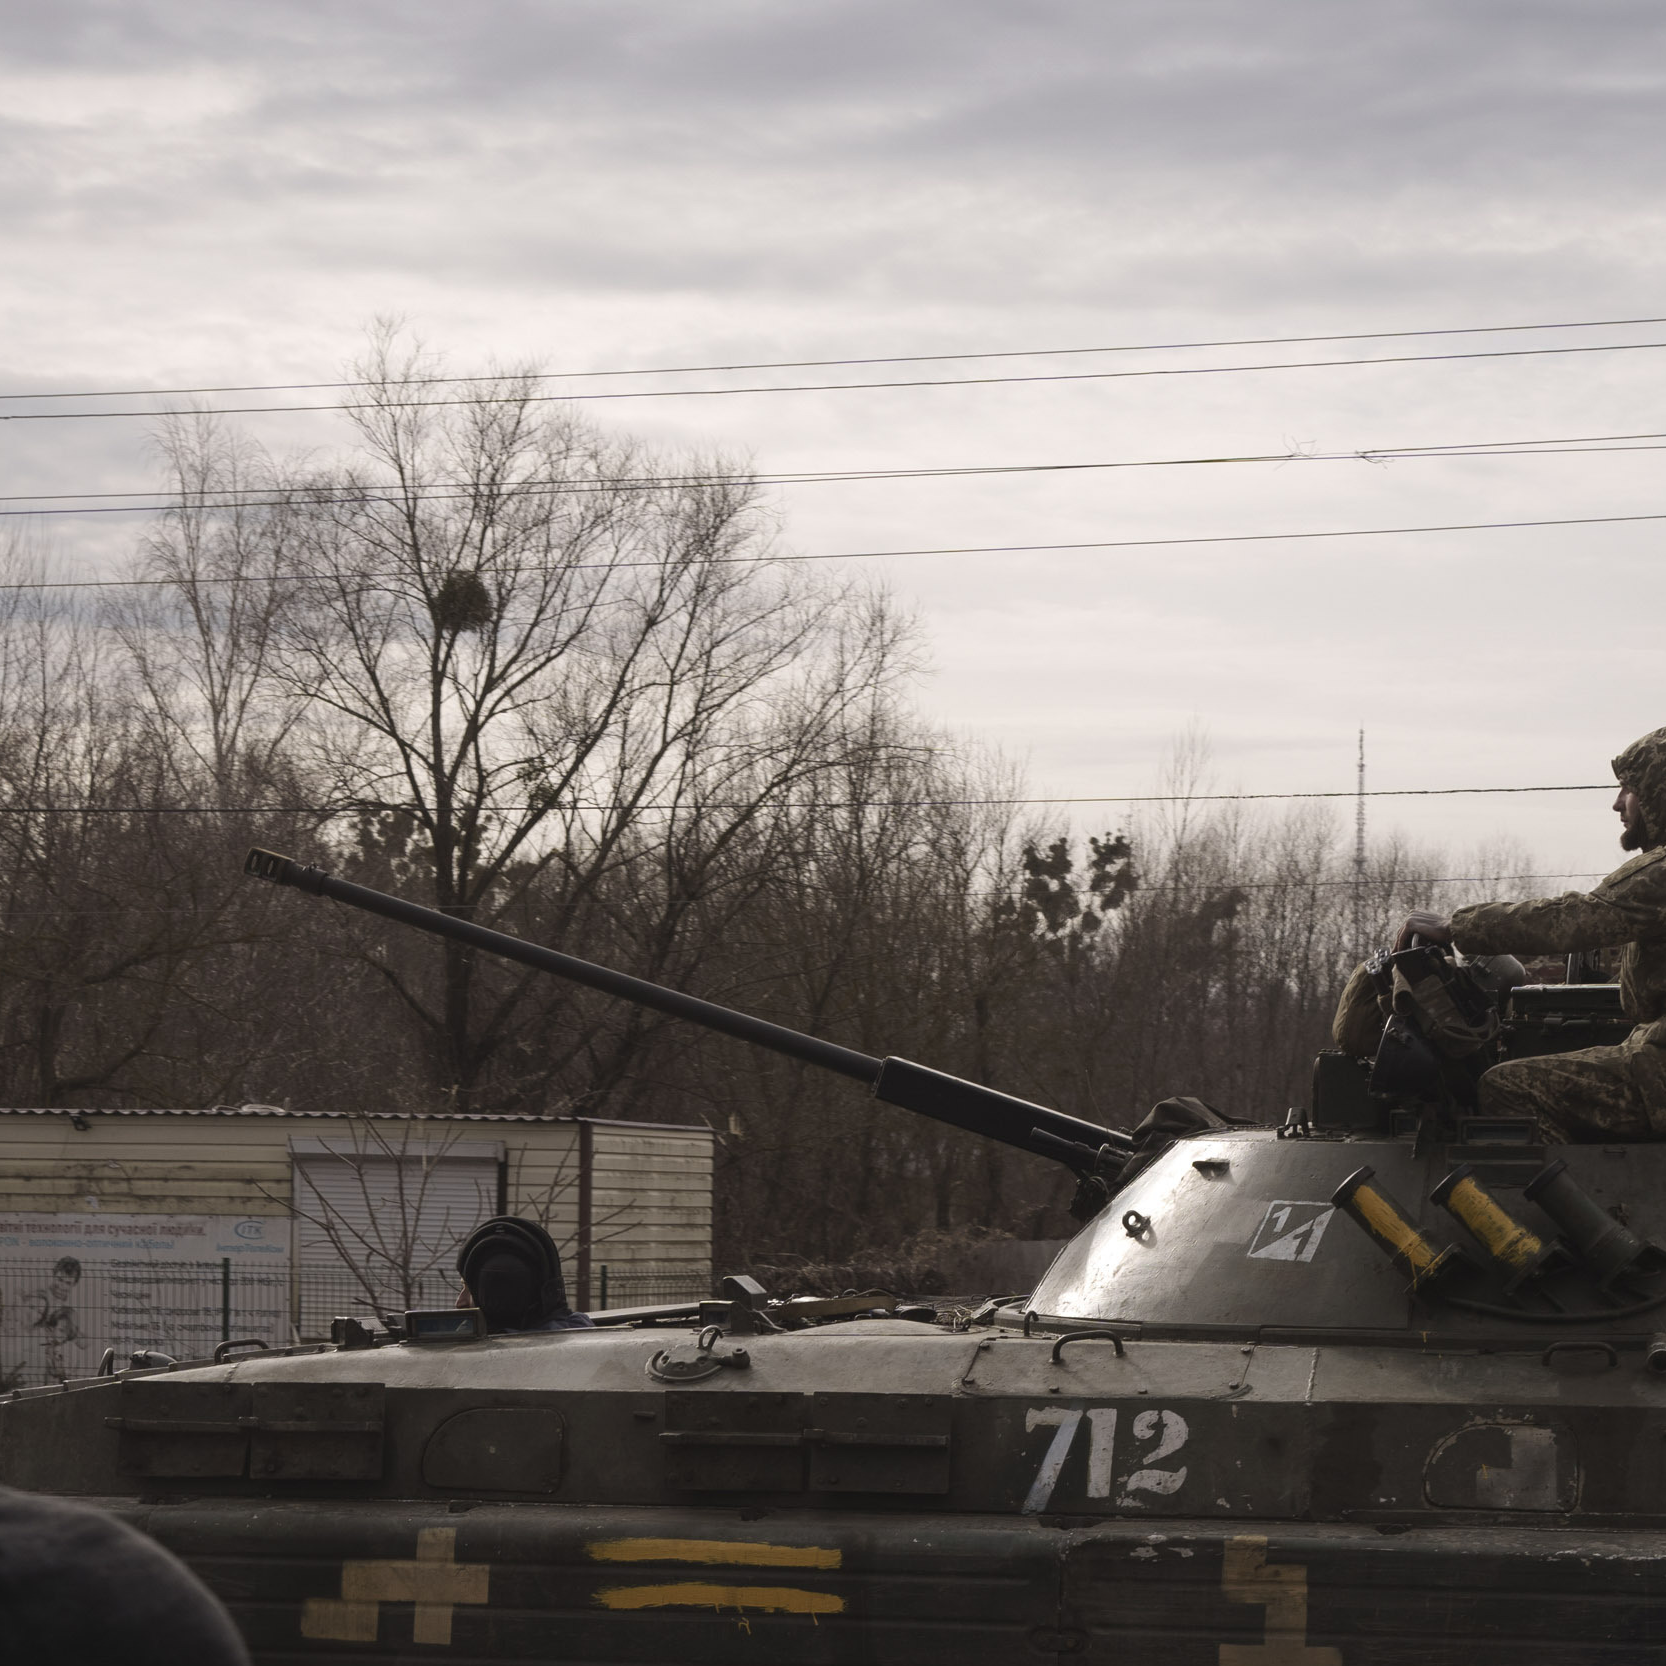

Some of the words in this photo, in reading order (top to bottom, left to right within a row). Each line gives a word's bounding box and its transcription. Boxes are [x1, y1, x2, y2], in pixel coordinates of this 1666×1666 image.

[26, 1220, 81, 1233] технології
[84, 1224, 105, 1236] для
[107, 1222, 158, 1237] сучасної
[1021, 1407, 1189, 1514] 712
